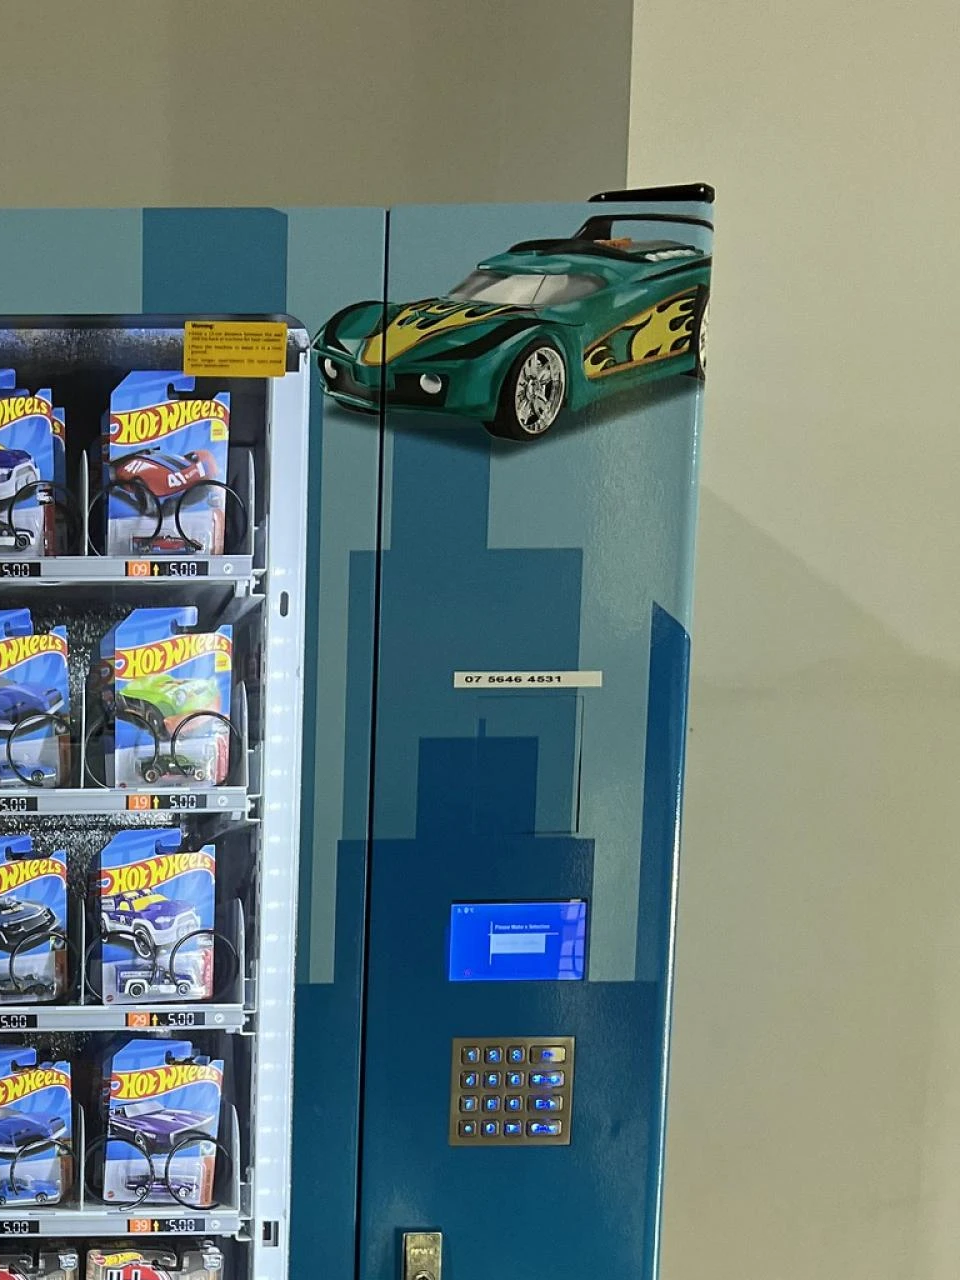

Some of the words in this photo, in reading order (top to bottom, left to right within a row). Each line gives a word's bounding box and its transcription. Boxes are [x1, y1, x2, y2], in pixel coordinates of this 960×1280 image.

[133, 563, 147, 575] 09
[133, 796, 148, 809] 19
[133, 1015, 147, 1026] 29
[135, 1220, 149, 1232] 39
